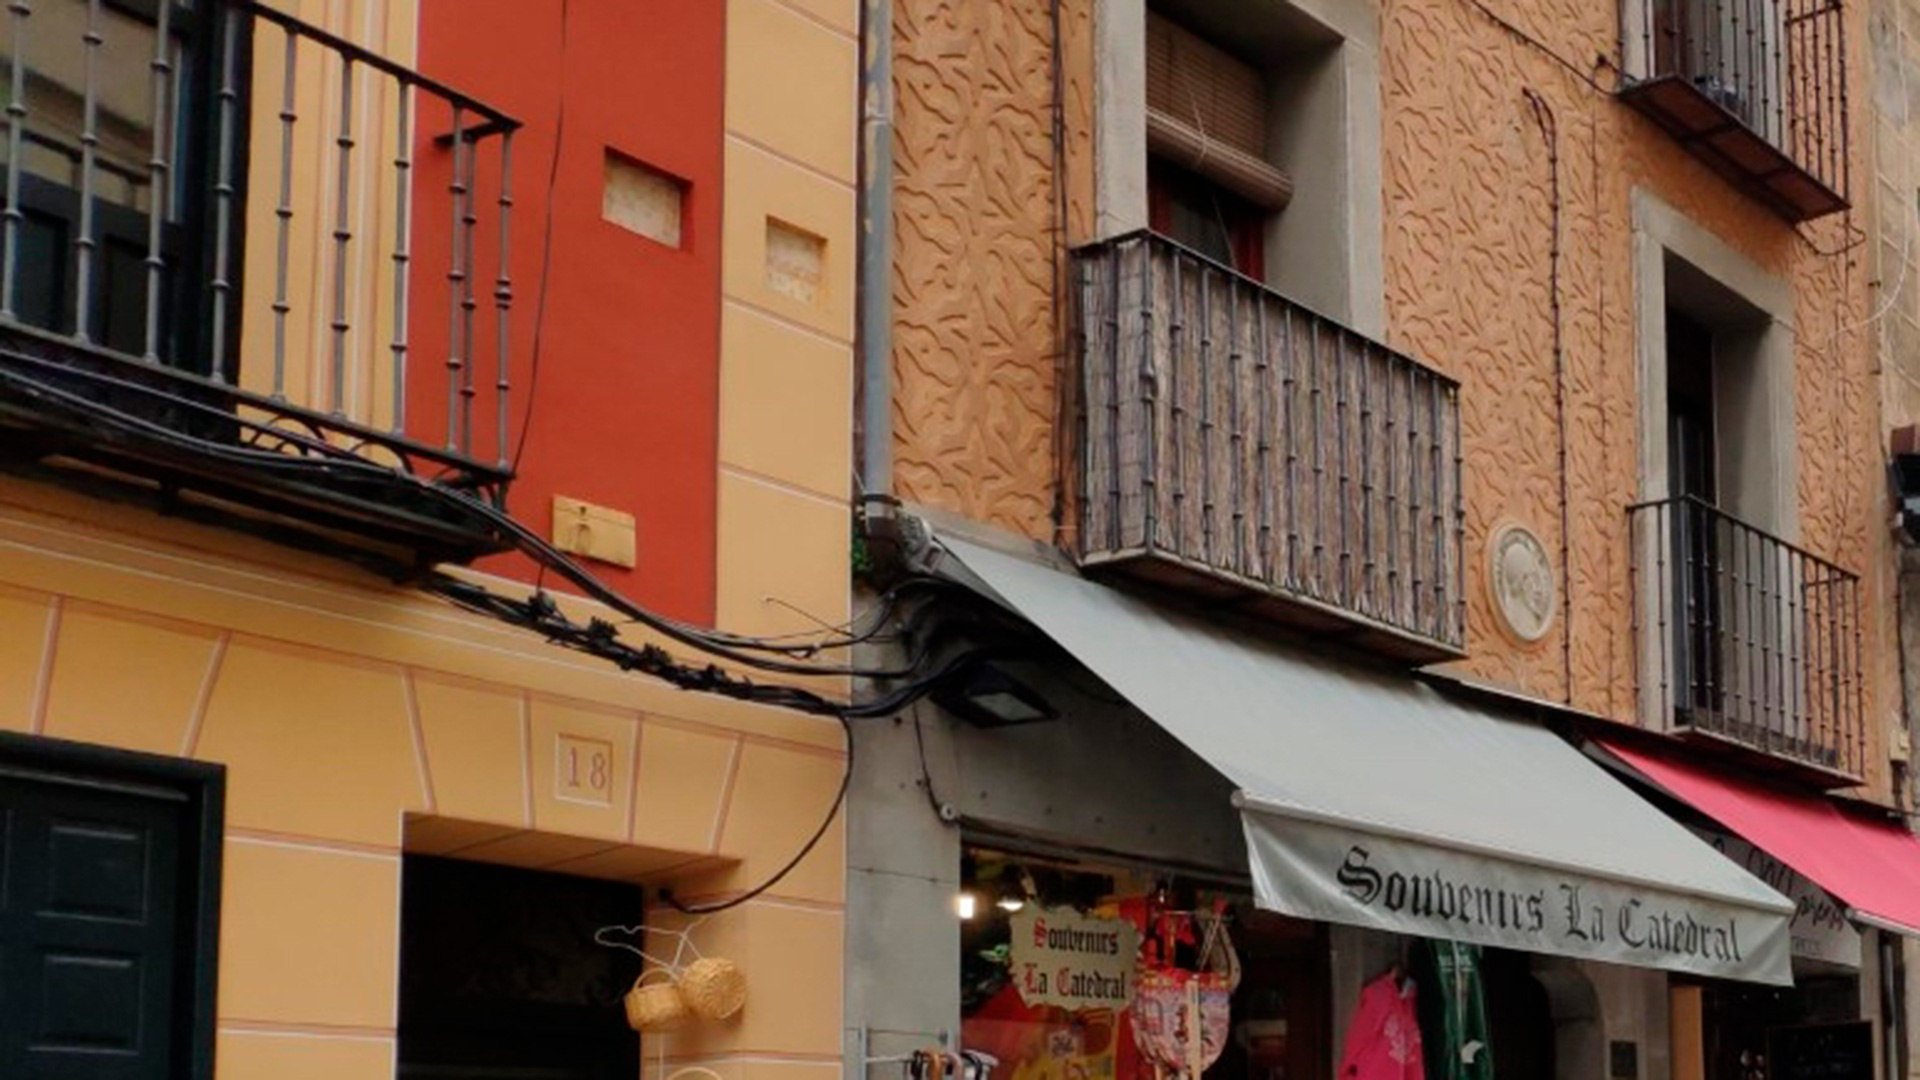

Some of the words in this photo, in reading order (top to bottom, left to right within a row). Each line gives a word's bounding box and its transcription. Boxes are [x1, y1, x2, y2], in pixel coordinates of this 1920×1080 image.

[567, 746, 606, 790] 18
[1337, 846, 1544, 932] Souvenirs
[1560, 883, 1605, 942] La
[1618, 898, 1742, 962] Catedral
[1033, 917, 1118, 955] Souvenirs
[1024, 962, 1048, 994] La
[1056, 967, 1125, 999] Catedral
